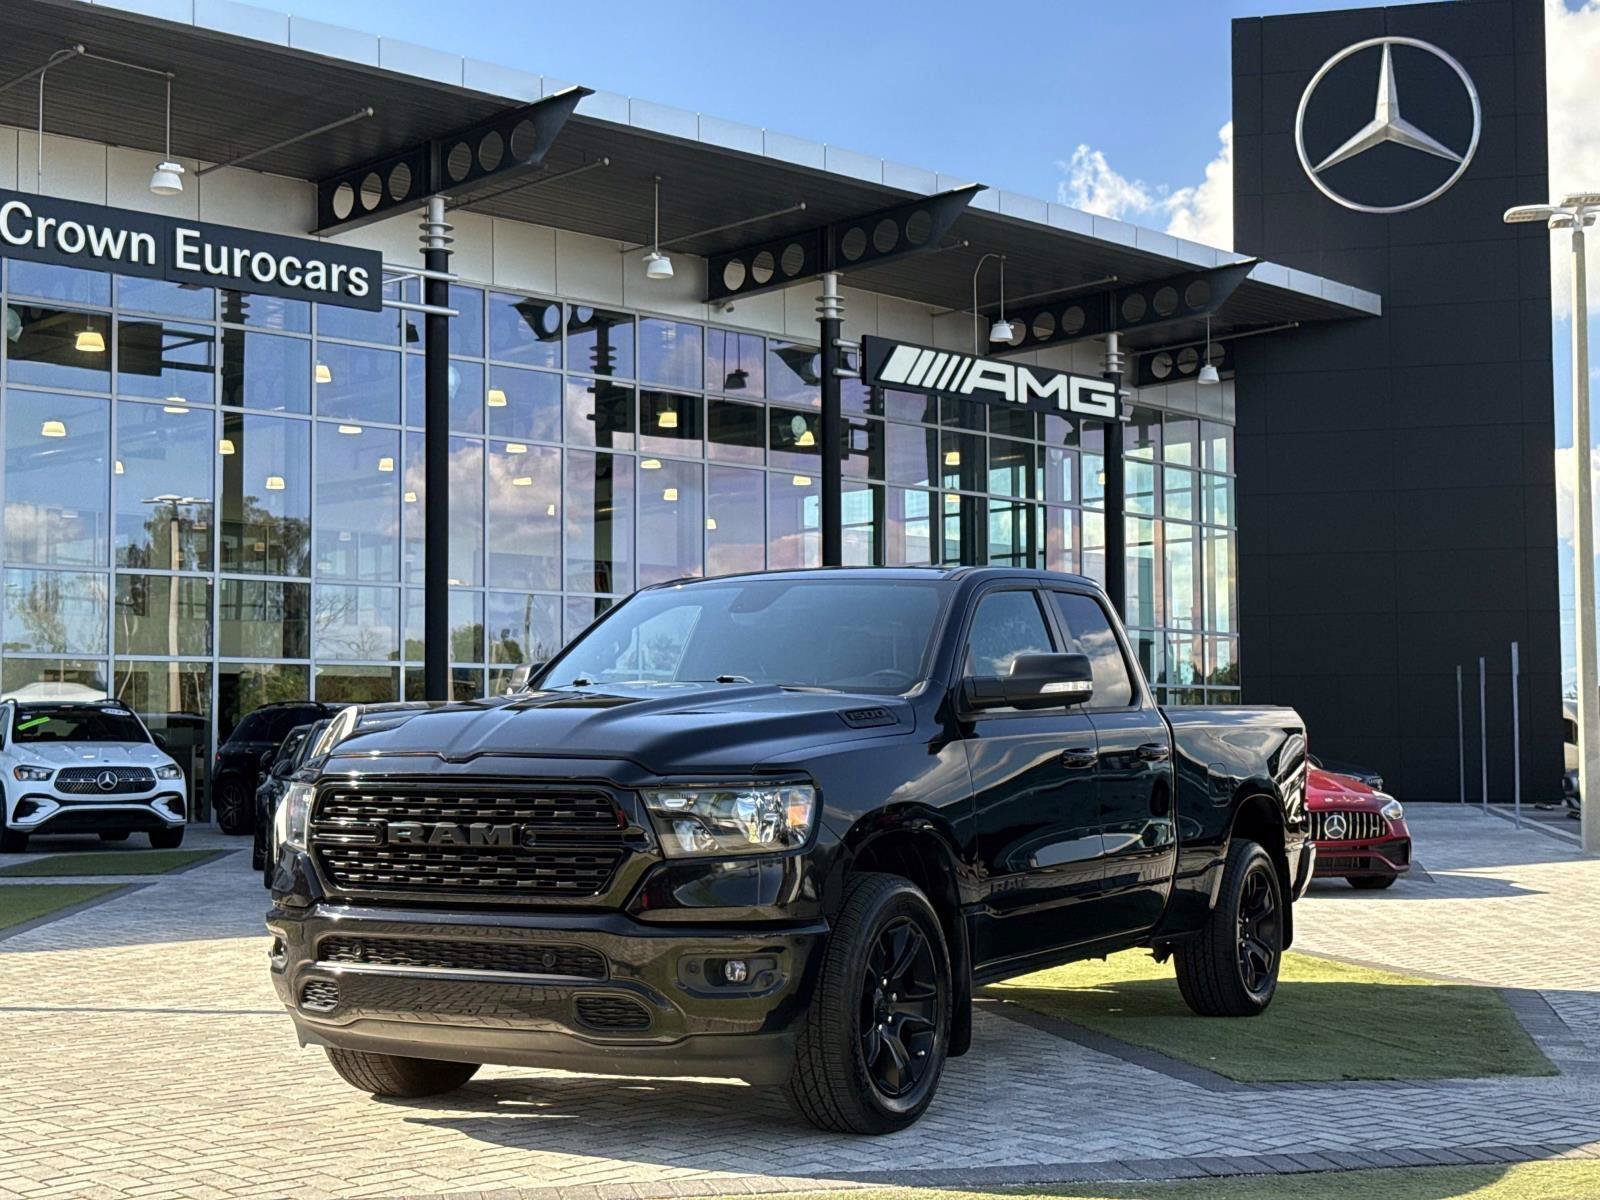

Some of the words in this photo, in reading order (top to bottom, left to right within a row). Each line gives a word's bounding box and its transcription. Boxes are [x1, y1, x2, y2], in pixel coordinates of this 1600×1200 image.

[0, 200, 156, 266] Crown
[175, 227, 370, 297] Eurocars
[960, 359, 1115, 417] AMG
[387, 821, 519, 847] RAM
